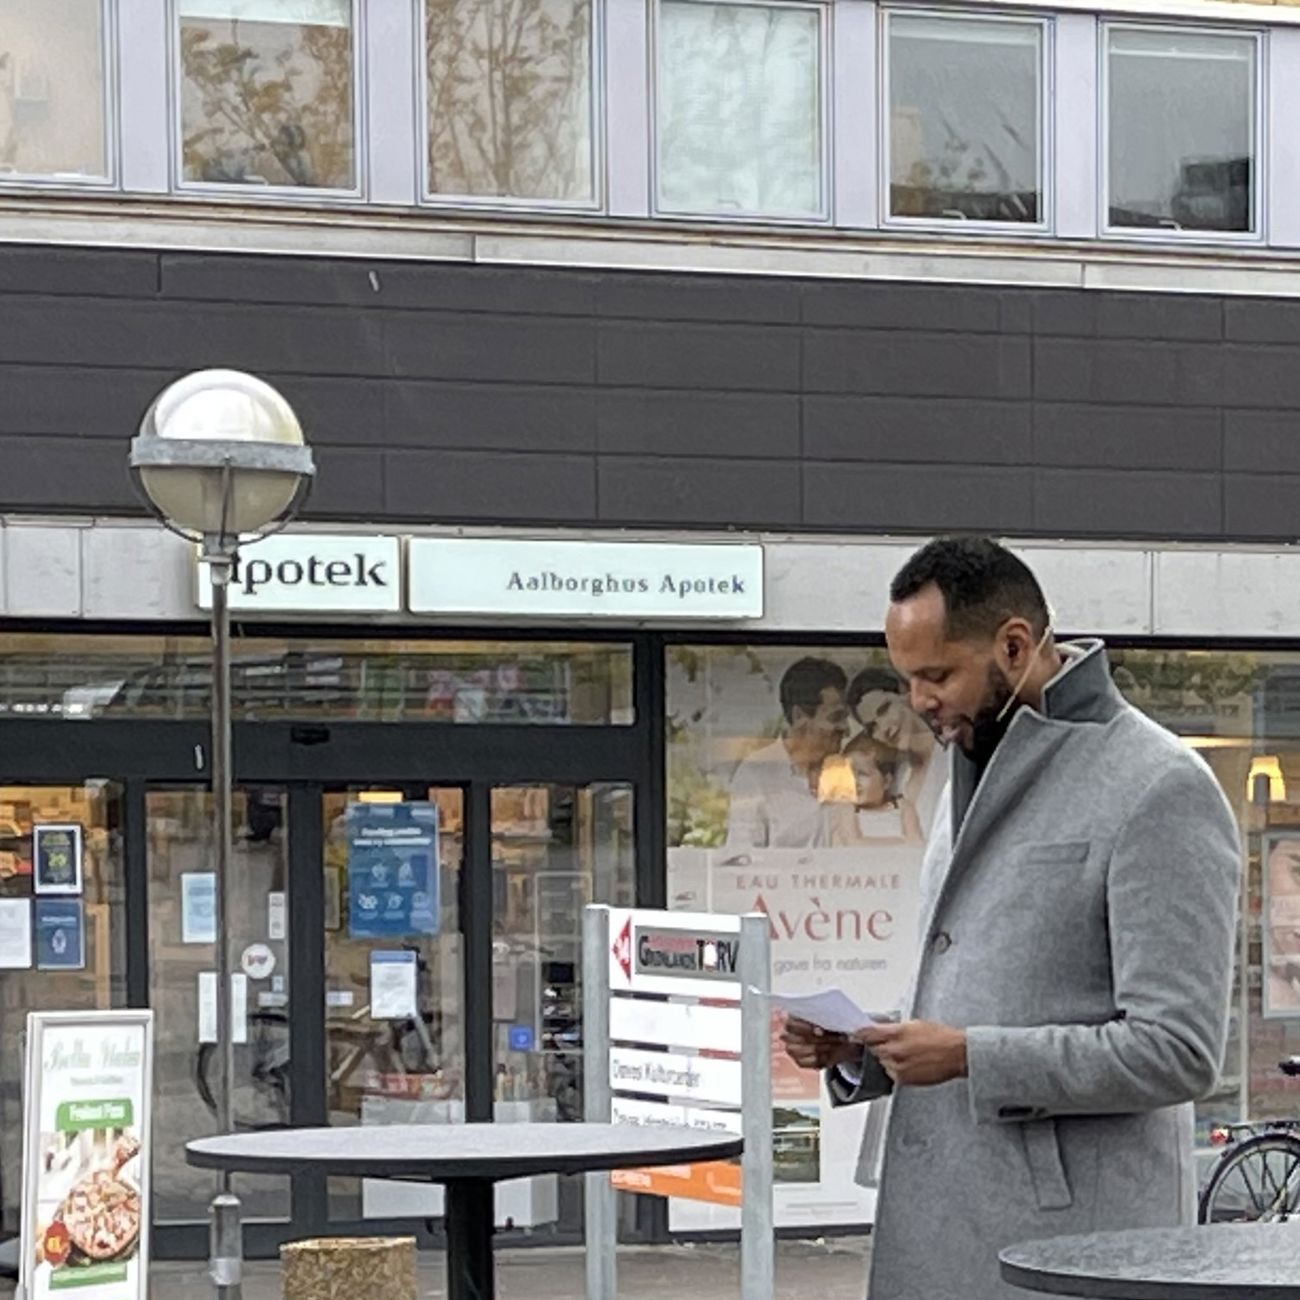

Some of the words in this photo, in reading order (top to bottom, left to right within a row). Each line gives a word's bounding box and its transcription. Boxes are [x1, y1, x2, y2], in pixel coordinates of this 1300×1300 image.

[506, 571, 649, 597] Aalborghus
[658, 573, 747, 599] Apotek
[735, 874, 779, 890] EAU
[791, 874, 901, 891] THERMALE
[752, 893, 894, 941] Avène
[835, 956, 888, 972] naturen
